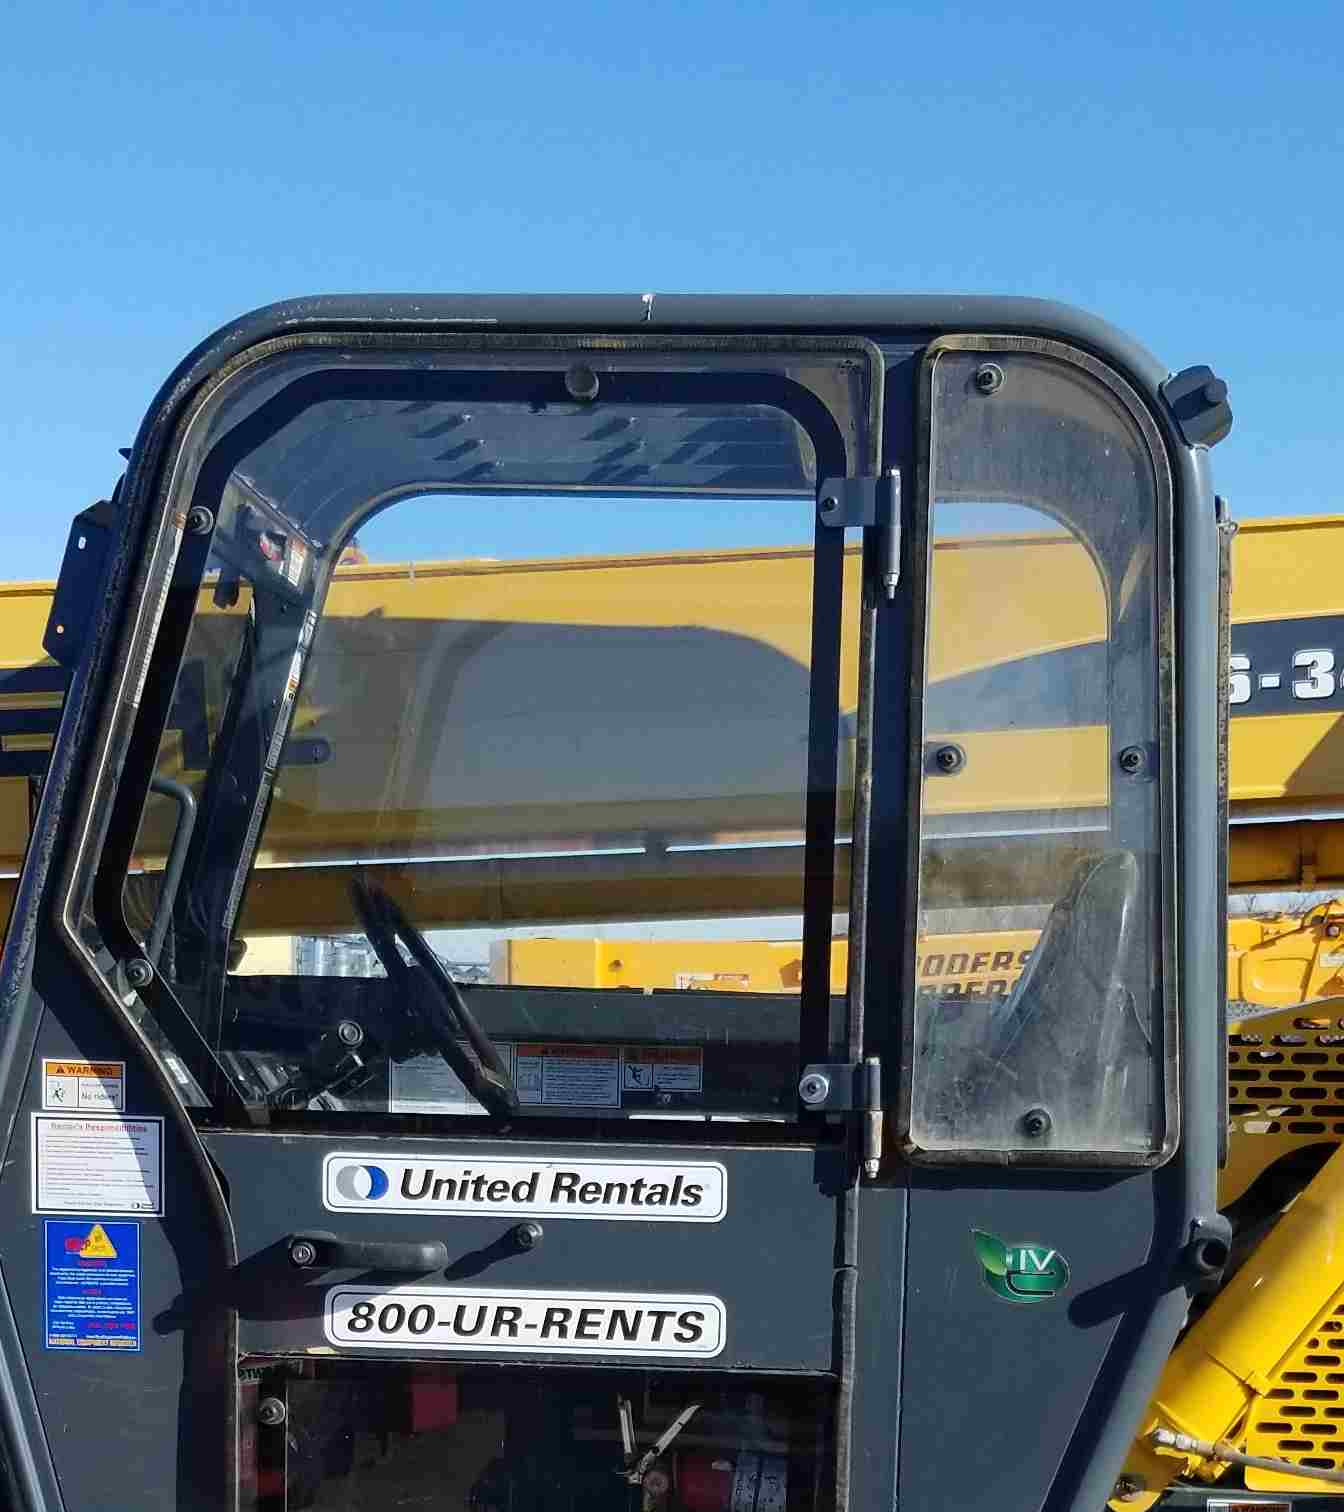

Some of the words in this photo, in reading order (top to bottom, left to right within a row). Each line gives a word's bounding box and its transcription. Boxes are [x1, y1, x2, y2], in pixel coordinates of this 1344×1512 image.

[67, 1065, 113, 1075] WARNING
[400, 1167, 538, 1203] United
[550, 1171, 705, 1208] Rentals
[347, 1302, 706, 1344] 800-UR-RENTS
